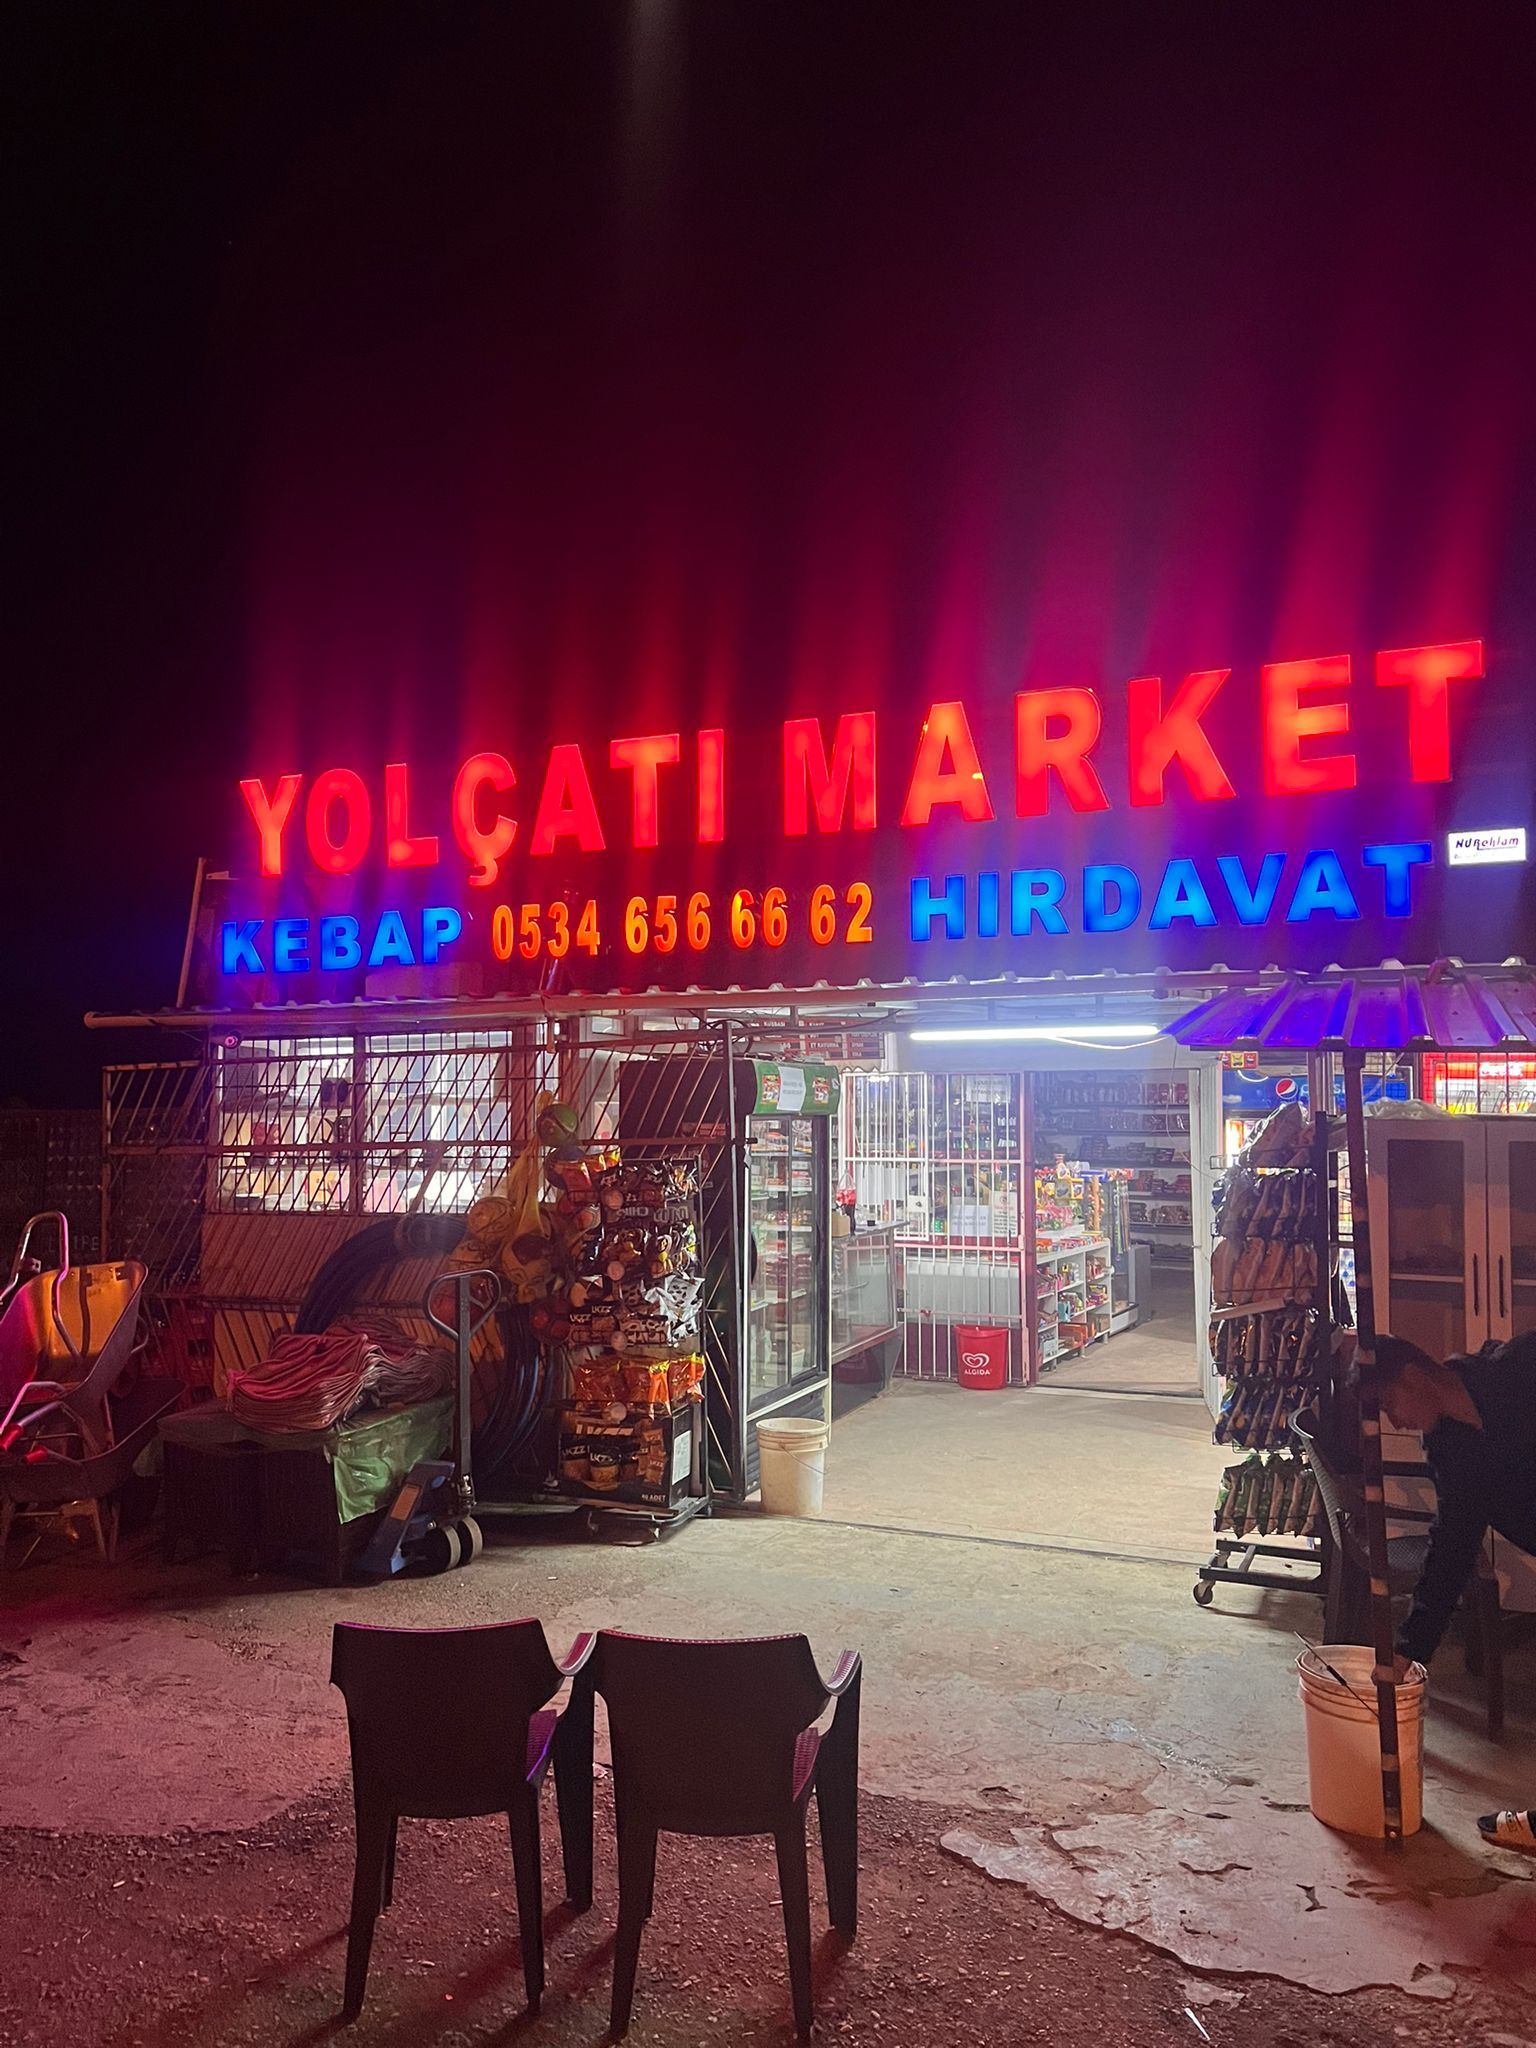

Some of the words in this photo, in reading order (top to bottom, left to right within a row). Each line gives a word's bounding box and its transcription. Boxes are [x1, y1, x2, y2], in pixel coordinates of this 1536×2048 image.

[240, 728, 724, 886] YOLÇATI
[782, 638, 1486, 836] MARKET
[492, 898, 601, 960] 0534
[625, 891, 711, 953] 656
[730, 886, 788, 949] 66
[809, 881, 873, 945] 62
[910, 841, 1433, 942] HIRDAVAT
[222, 906, 462, 975] KEBAP
[964, 1368, 991, 1376] ALGIDA
